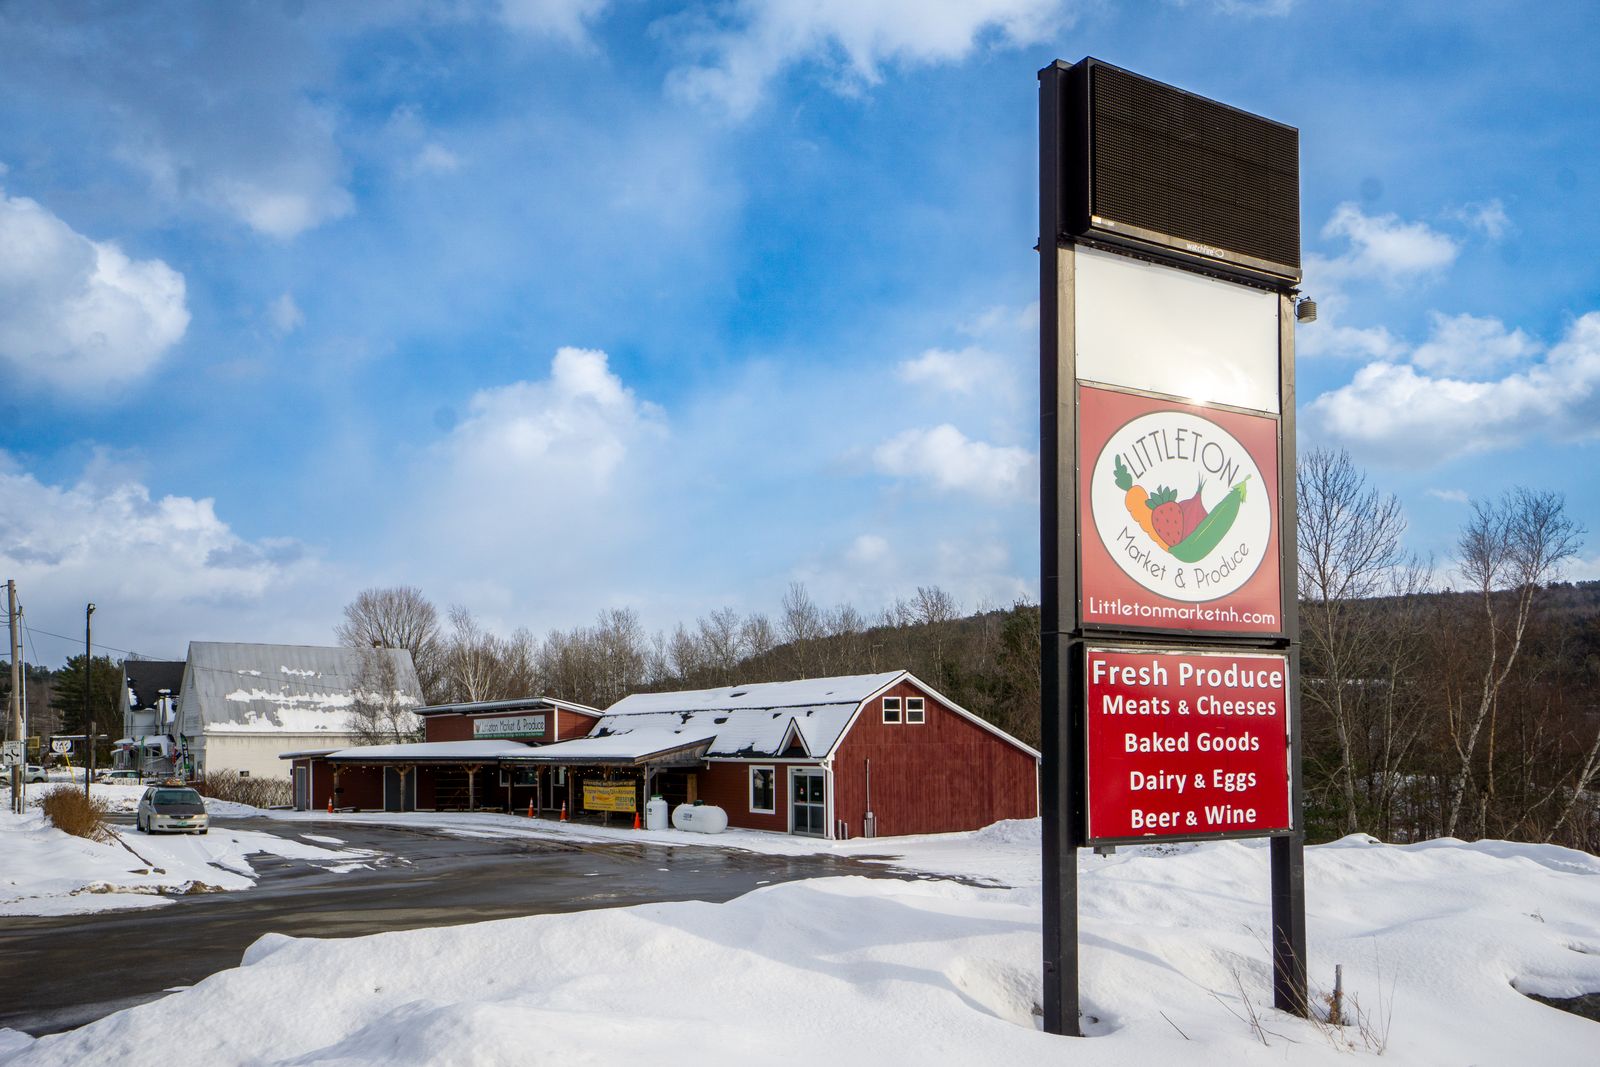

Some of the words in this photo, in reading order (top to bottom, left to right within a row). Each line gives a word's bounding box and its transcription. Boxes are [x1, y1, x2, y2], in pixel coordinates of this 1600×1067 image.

[1186, 243, 1214, 257] watchfire
[1123, 428, 1240, 487] LITTLETON
[1117, 526, 1166, 580] Market
[1174, 568, 1186, 588] &
[1194, 543, 1249, 588] Produce
[1089, 597, 1275, 625] Littletonmarketnh.com
[1093, 660, 1168, 686] Fresh
[1179, 663, 1282, 688] Produce
[1103, 695, 1170, 715] Meats
[1178, 699, 1190, 715] &
[1196, 695, 1276, 716] Cheeses
[1125, 732, 1189, 753] Baked
[1196, 732, 1260, 751] Goods
[1130, 770, 1187, 793] Dairy
[1194, 773, 1206, 788] &
[1213, 769, 1257, 792] Eggs
[1131, 809, 1180, 828] Beer
[1185, 810, 1198, 826] &
[1204, 805, 1257, 825] Wine
